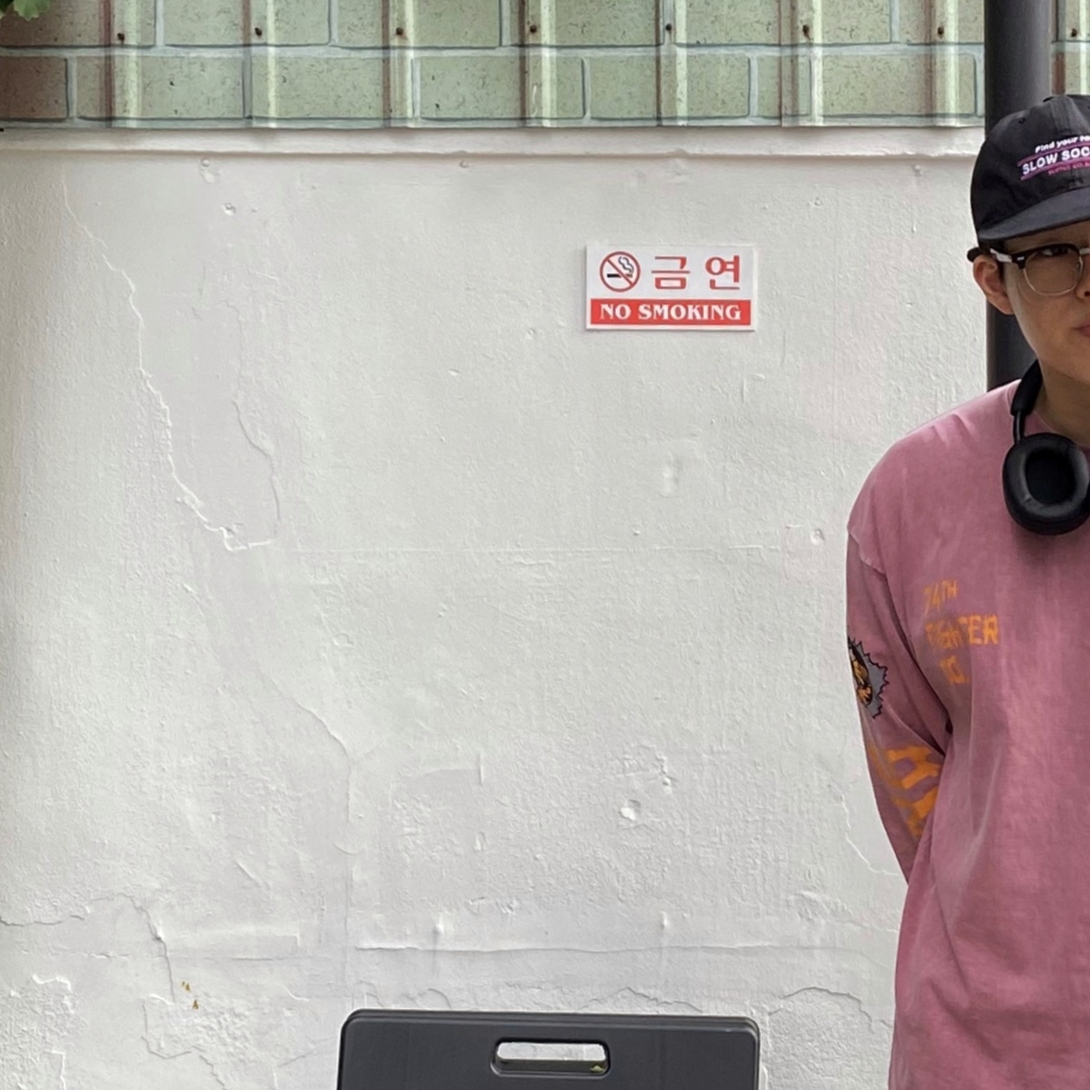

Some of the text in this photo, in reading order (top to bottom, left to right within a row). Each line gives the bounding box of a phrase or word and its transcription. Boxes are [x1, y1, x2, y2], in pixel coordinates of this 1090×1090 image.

[1056, 136, 1078, 148] your
[1022, 152, 1058, 175] SLOW
[600, 303, 742, 321] NO SMOKING
